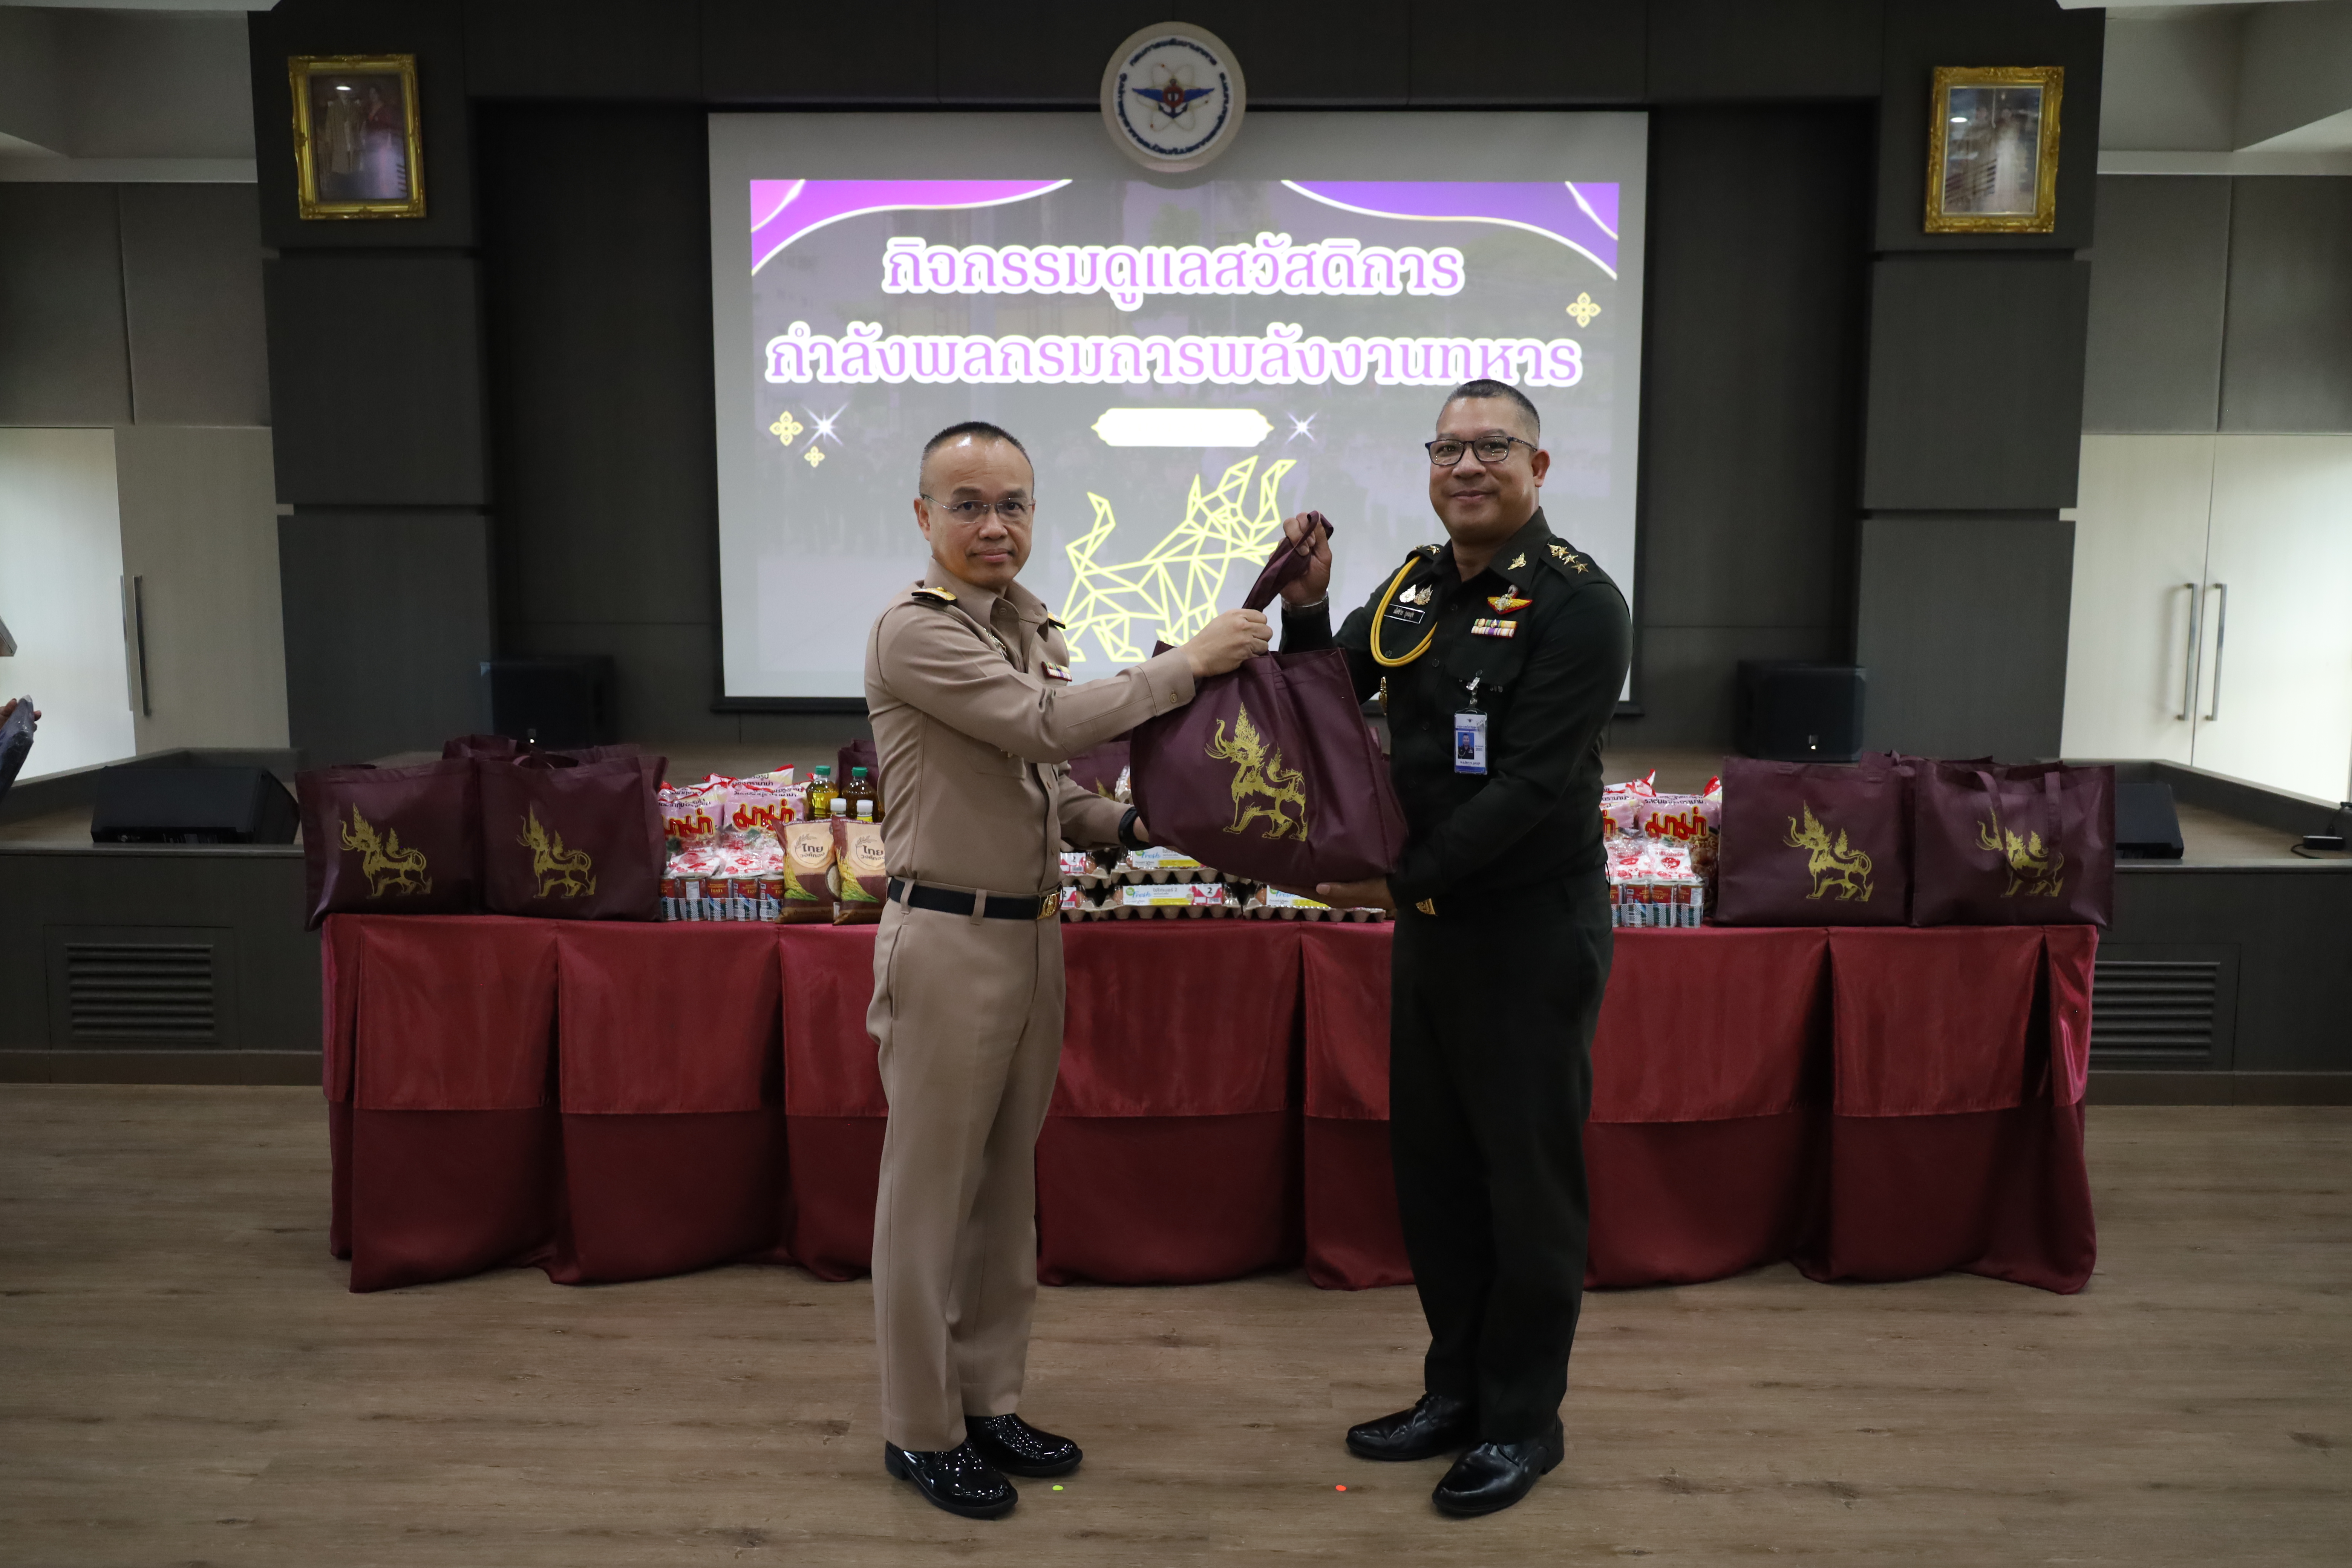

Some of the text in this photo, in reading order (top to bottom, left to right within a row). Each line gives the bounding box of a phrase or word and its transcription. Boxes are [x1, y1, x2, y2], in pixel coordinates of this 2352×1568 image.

[887, 238, 1461, 305] กิจกรรมดูแลสวัสดิการ
[770, 326, 1579, 379] กำลังพลกรมการพลังงานทหาร
[663, 807, 714, 839] าม่า
[732, 798, 795, 831] มาม่า
[1645, 806, 1706, 840] มาม่า
[802, 843, 823, 853] ไทย
[862, 845, 884, 856] ไทย
